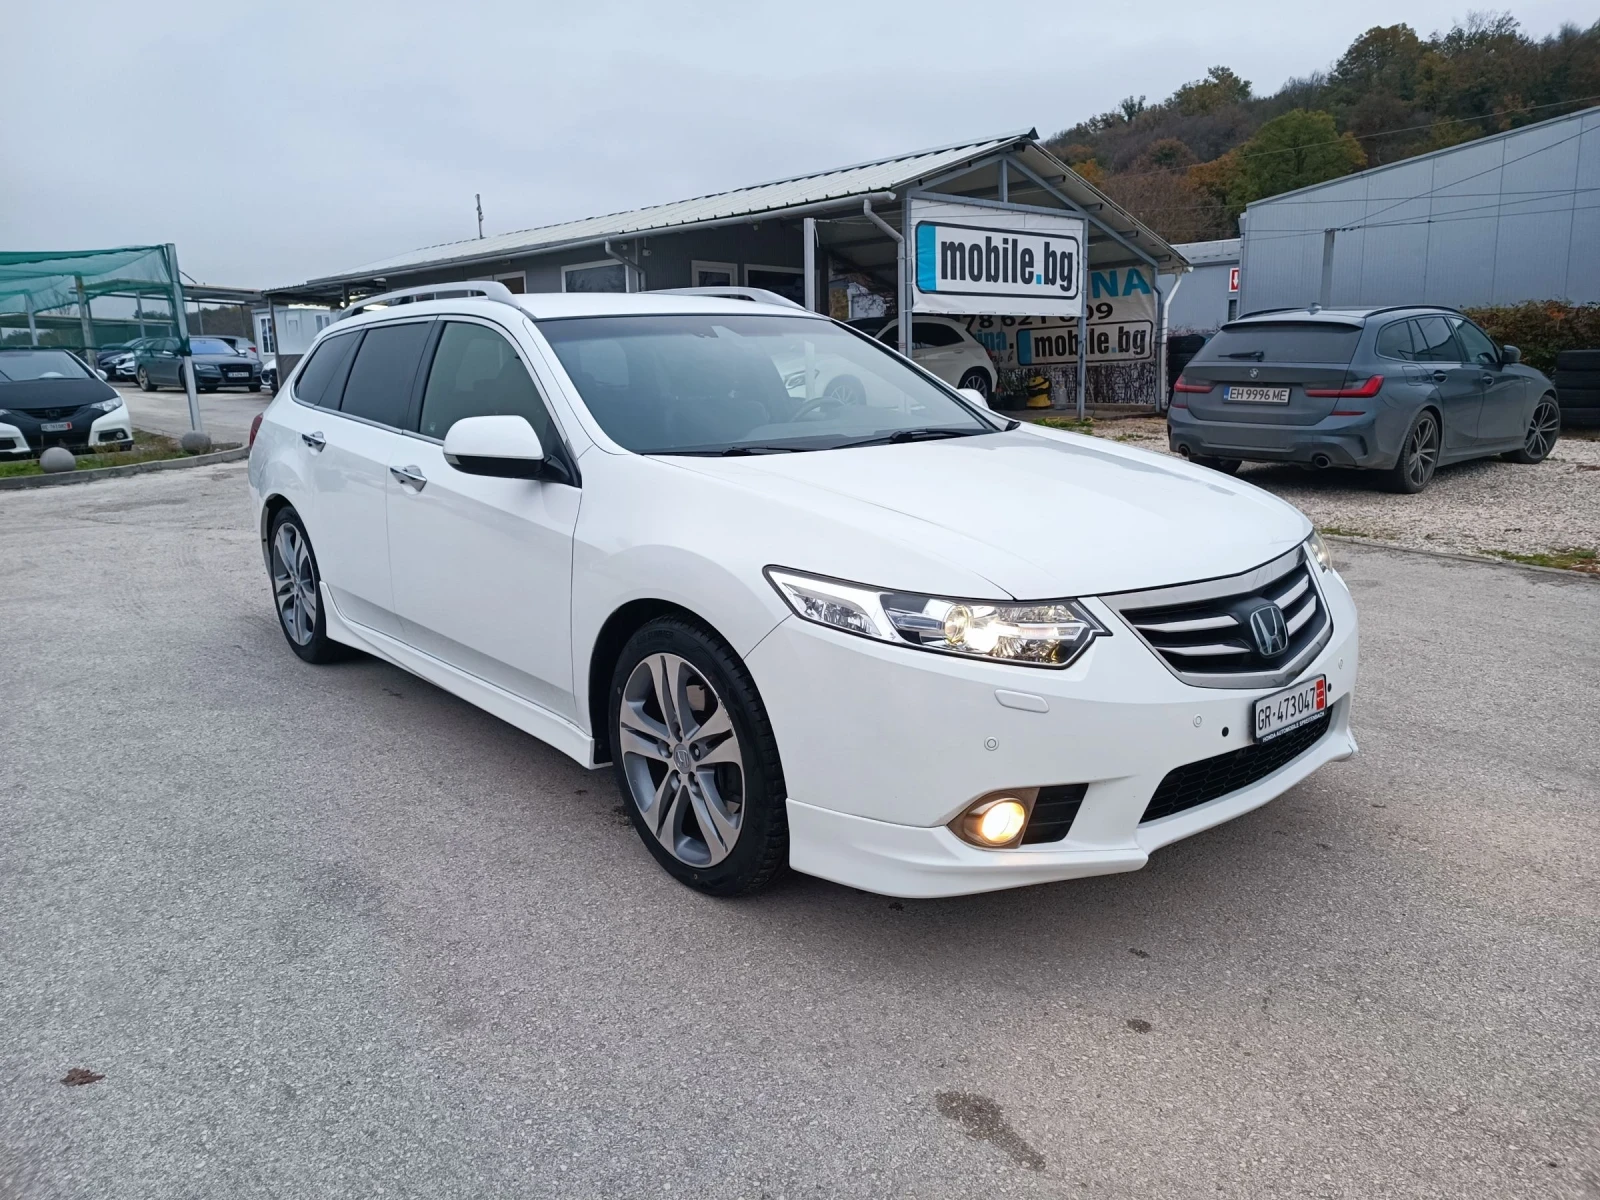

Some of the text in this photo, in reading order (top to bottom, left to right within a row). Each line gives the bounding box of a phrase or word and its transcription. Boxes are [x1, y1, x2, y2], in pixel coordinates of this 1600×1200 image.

[941, 236, 1073, 292] mobile.bg
[1034, 326, 1147, 357] moble.bg
[1229, 388, 1244, 399] EH
[1246, 388, 1271, 400] 9996
[1272, 389, 1288, 401] ME
